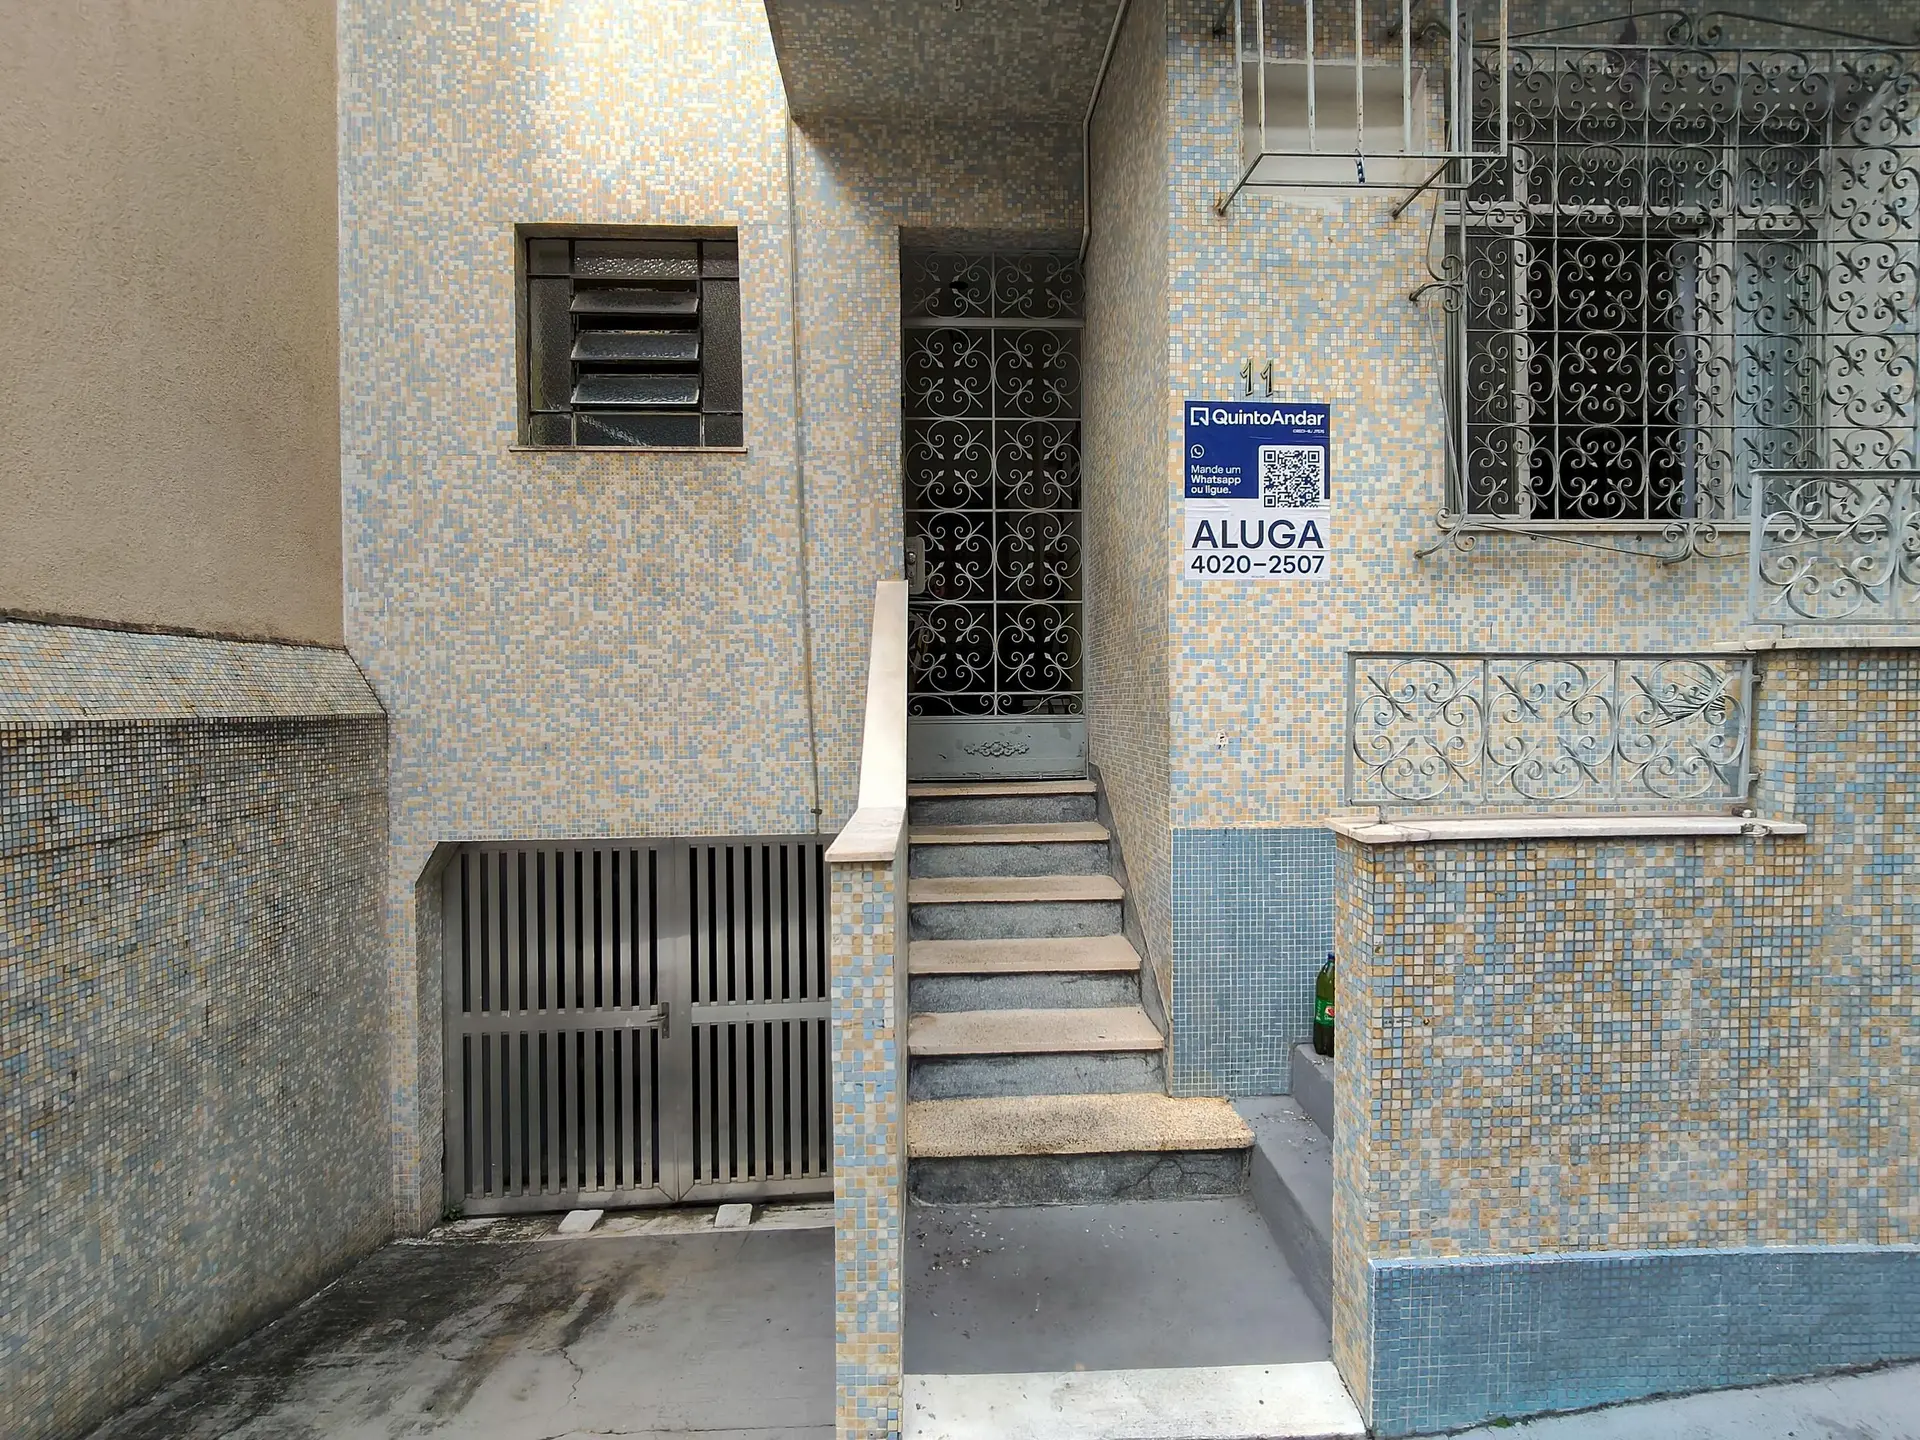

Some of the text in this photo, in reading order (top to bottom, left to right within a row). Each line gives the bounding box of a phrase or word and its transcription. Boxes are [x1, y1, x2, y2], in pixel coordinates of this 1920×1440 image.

[1240, 356, 1274, 397] 11
[1212, 408, 1325, 426] QuintoAndar
[1190, 464, 1241, 474] Mande um
[1190, 474, 1242, 486] Whatsapp
[1190, 484, 1232, 496] ou ligue.
[1191, 519, 1324, 549] ALUGA
[1190, 554, 1325, 574] 4020-2507
